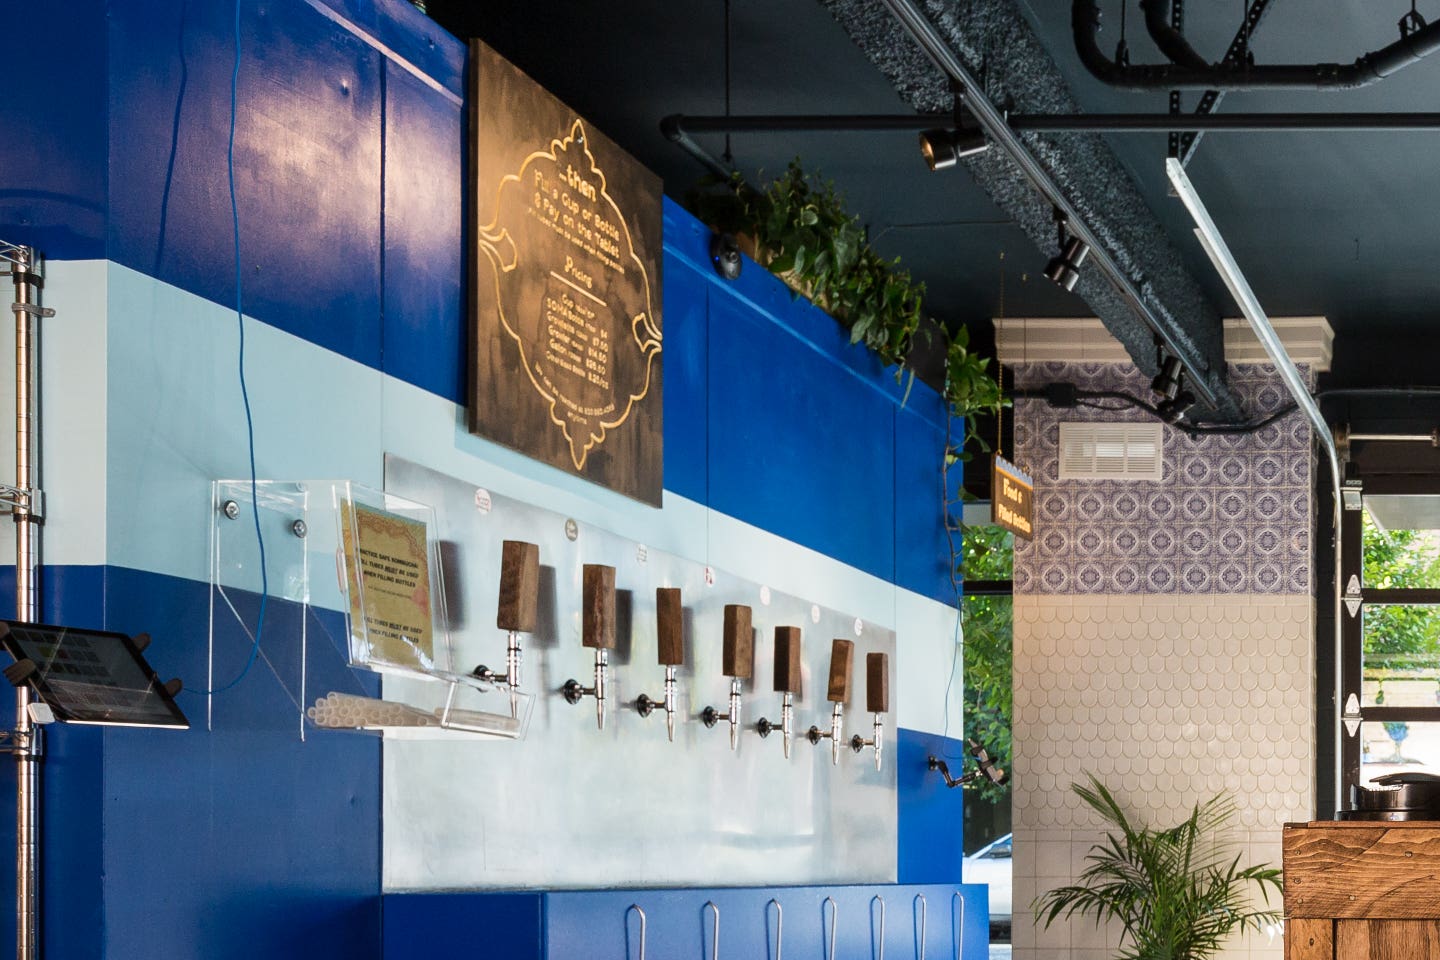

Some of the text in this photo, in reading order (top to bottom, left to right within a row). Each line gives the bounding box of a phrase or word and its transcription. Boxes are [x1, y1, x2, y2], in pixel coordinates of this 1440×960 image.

[559, 164, 596, 202] ...then
[543, 198, 560, 222] Pay
[563, 214, 574, 229] on
[577, 222, 592, 240] the
[594, 232, 619, 259] Tablet
[553, 189, 559, 199] a
[582, 209, 592, 221] or
[594, 214, 619, 241] Bottle
[564, 255, 592, 289] Pricing
